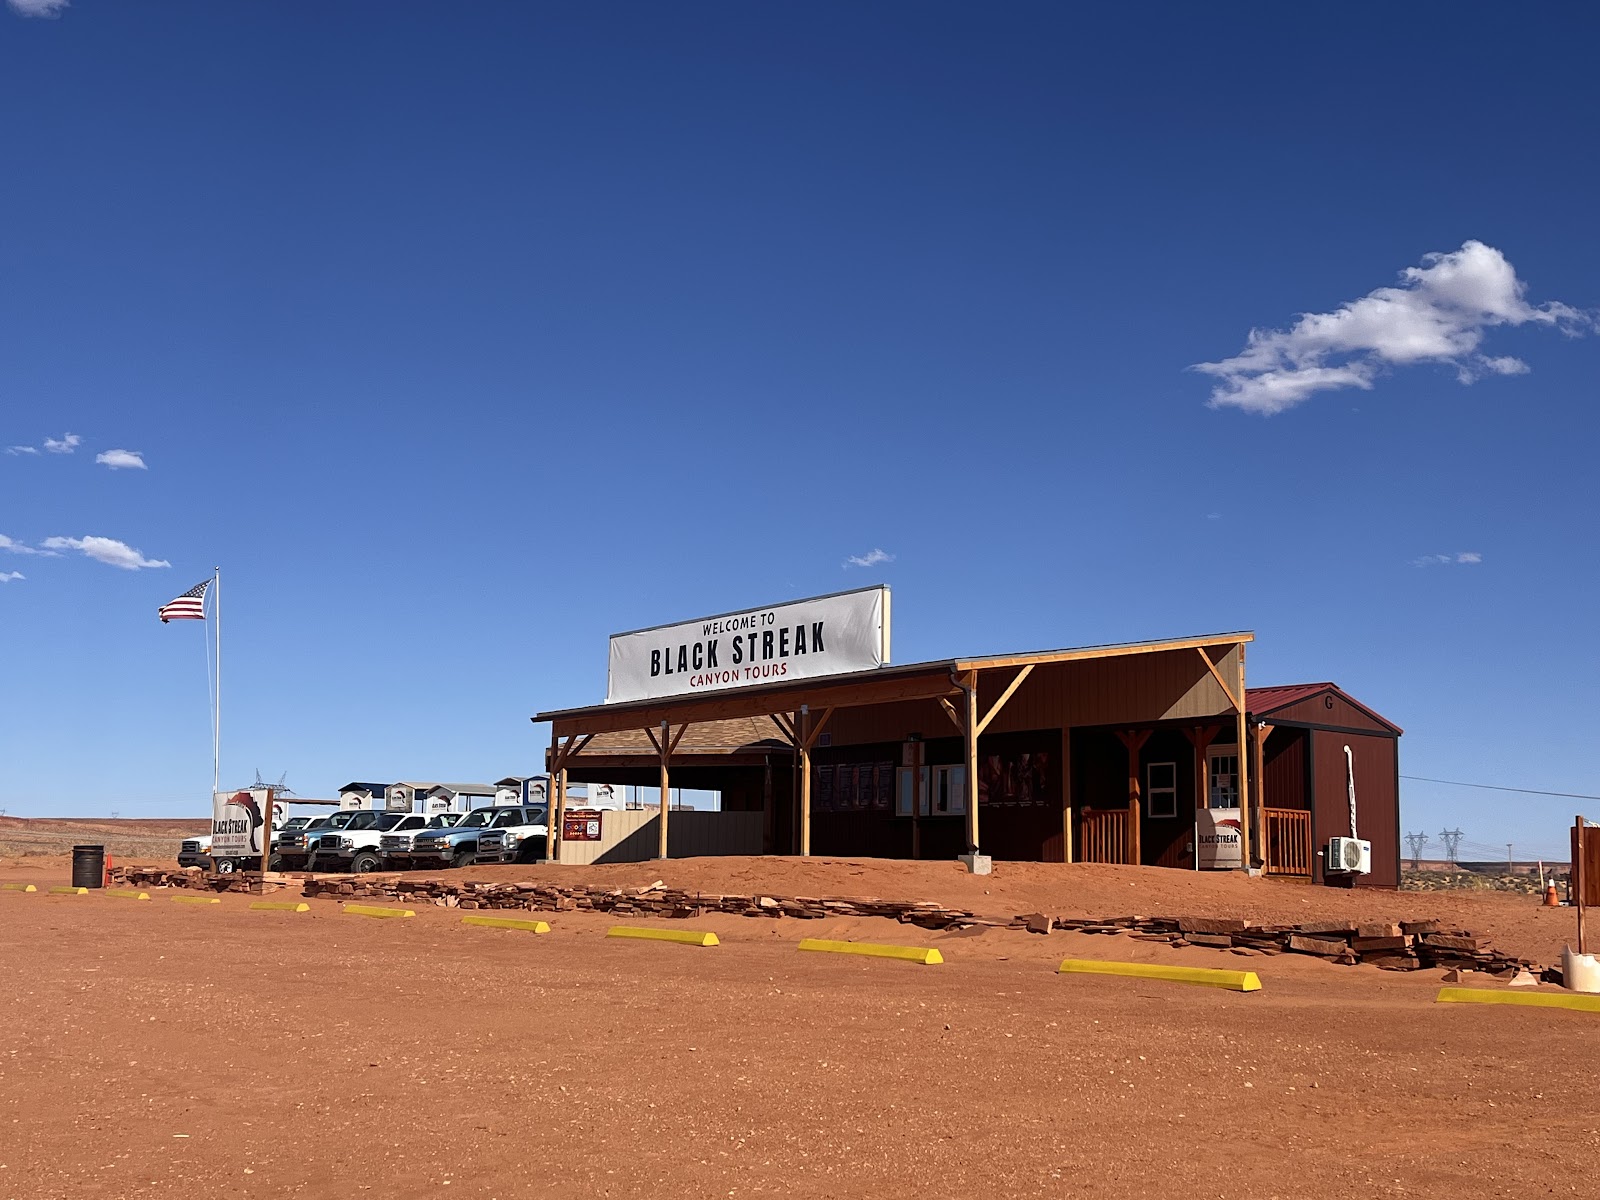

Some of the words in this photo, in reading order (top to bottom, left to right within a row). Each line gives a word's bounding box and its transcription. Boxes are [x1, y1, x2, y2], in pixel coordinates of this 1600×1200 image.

[702, 615, 756, 636] WELCOME
[761, 612, 775, 626] TO
[650, 639, 719, 677] BLACK
[732, 621, 825, 665] STREAK
[689, 669, 739, 687] CANYON
[744, 662, 787, 680] TOURS
[1325, 695, 1333, 710] G
[228, 818, 248, 834] STREAK
[231, 835, 247, 843] TOURS
[1215, 834, 1238, 844] STREAK
